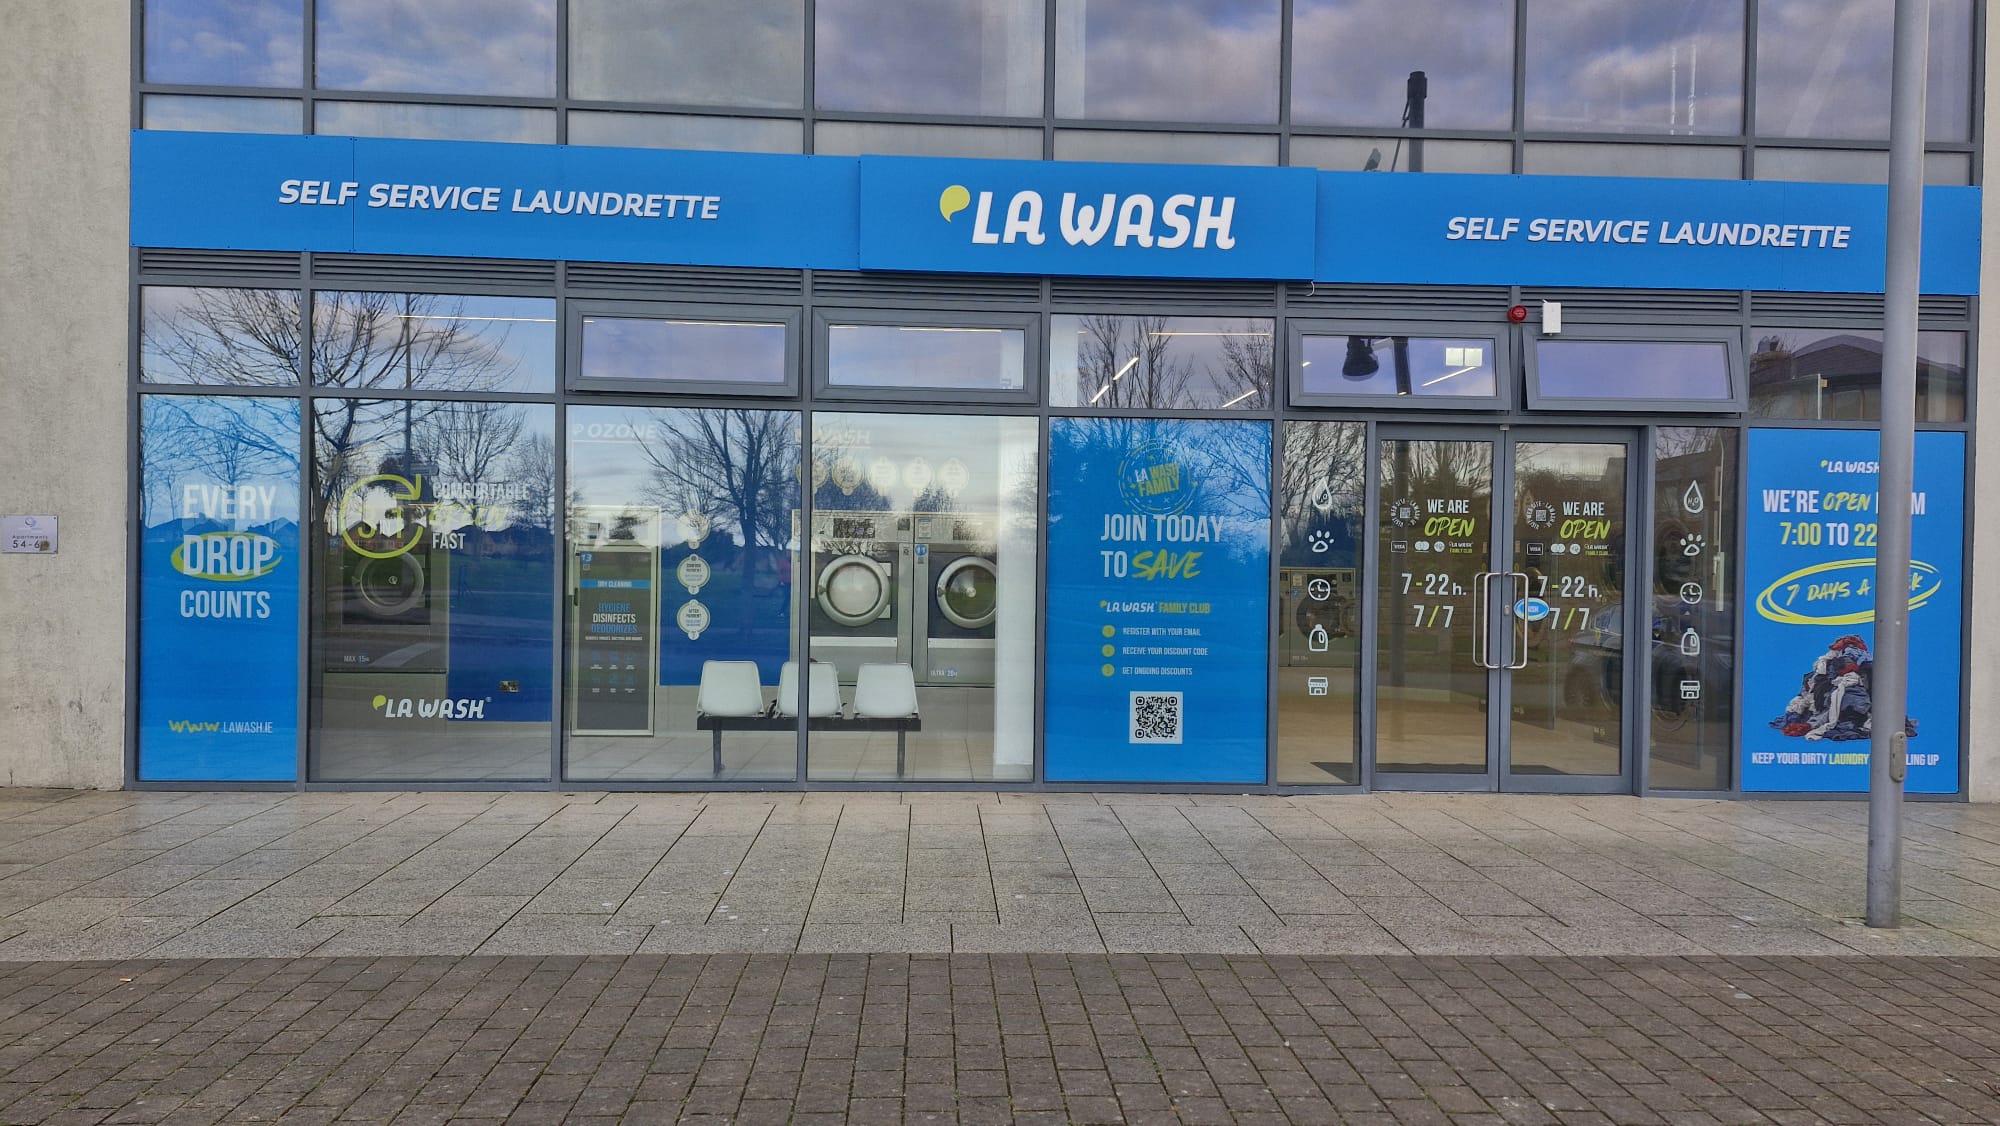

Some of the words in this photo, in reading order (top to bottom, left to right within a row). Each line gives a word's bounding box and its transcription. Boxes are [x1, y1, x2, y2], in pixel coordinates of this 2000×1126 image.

[278, 179, 358, 205] SELF
[368, 183, 500, 211] SERVICE
[511, 189, 720, 220] LAUNDRETTE
[971, 190, 1045, 246] LA
[1060, 191, 1236, 250] WASH
[1446, 216, 1519, 241] SELF
[1527, 219, 1649, 244] SERVICE
[1658, 222, 1851, 249] LAUNDRETTE
[1134, 467, 1149, 482] LA
[1149, 461, 1179, 480] WASH
[1827, 461, 1843, 473] LA
[432, 481, 530, 500] COMFORTABLE
[1137, 475, 1179, 497] FAMILY
[182, 483, 276, 519] EVERY
[1427, 499, 1444, 513] WE
[1447, 499, 1470, 514] ARE
[1562, 501, 1580, 516] WE
[1583, 502, 1605, 516] ARE
[1763, 489, 1819, 513] WE'RE
[1822, 492, 1871, 511] OPEN
[1101, 514, 1147, 542] JOIN
[1152, 514, 1224, 543] TODAY
[1424, 516, 1475, 537] OPEN
[1560, 518, 1611, 540] OPEN
[1779, 522, 1821, 545] 7:00
[1826, 522, 1849, 545] TO
[432, 532, 466, 550] FAST
[183, 534, 274, 577] DROP
[1101, 551, 1128, 578] TO
[1131, 548, 1204, 581] SAVE
[1786, 584, 1799, 606] 7
[1807, 581, 1850, 601] DAYS
[1856, 578, 1871, 596] A
[180, 590, 271, 619] COUNTS
[597, 602, 631, 613] HYGIENE
[1106, 602, 1120, 613] LA
[1122, 602, 1155, 613] WASH
[1158, 602, 1187, 613] FAMILY
[1188, 602, 1210, 614] CLUB
[592, 612, 636, 623] DISINFECTS
[1122, 627, 1151, 635] REGISTER
[1151, 628, 1167, 636] WITH
[1167, 628, 1183, 636] YOUR
[1122, 647, 1147, 655] RECEIVE
[1147, 647, 1163, 655] YOUR
[1163, 647, 1192, 655] DISCOUNT
[1193, 648, 1209, 656] CODE
[1122, 666, 1133, 675] GET
[1134, 667, 1160, 675] ONGOING
[1160, 667, 1193, 676] DISCOUNTS
[385, 698, 413, 718] LA
[418, 698, 485, 719] WASH
[1752, 752, 1775, 764] KEEP
[1776, 752, 1800, 765] YOUR
[1801, 753, 1827, 765] DIRTY
[1829, 753, 1870, 765] LAUNDRY
[1906, 754, 1925, 766] LING
[1927, 754, 1939, 766] UP
